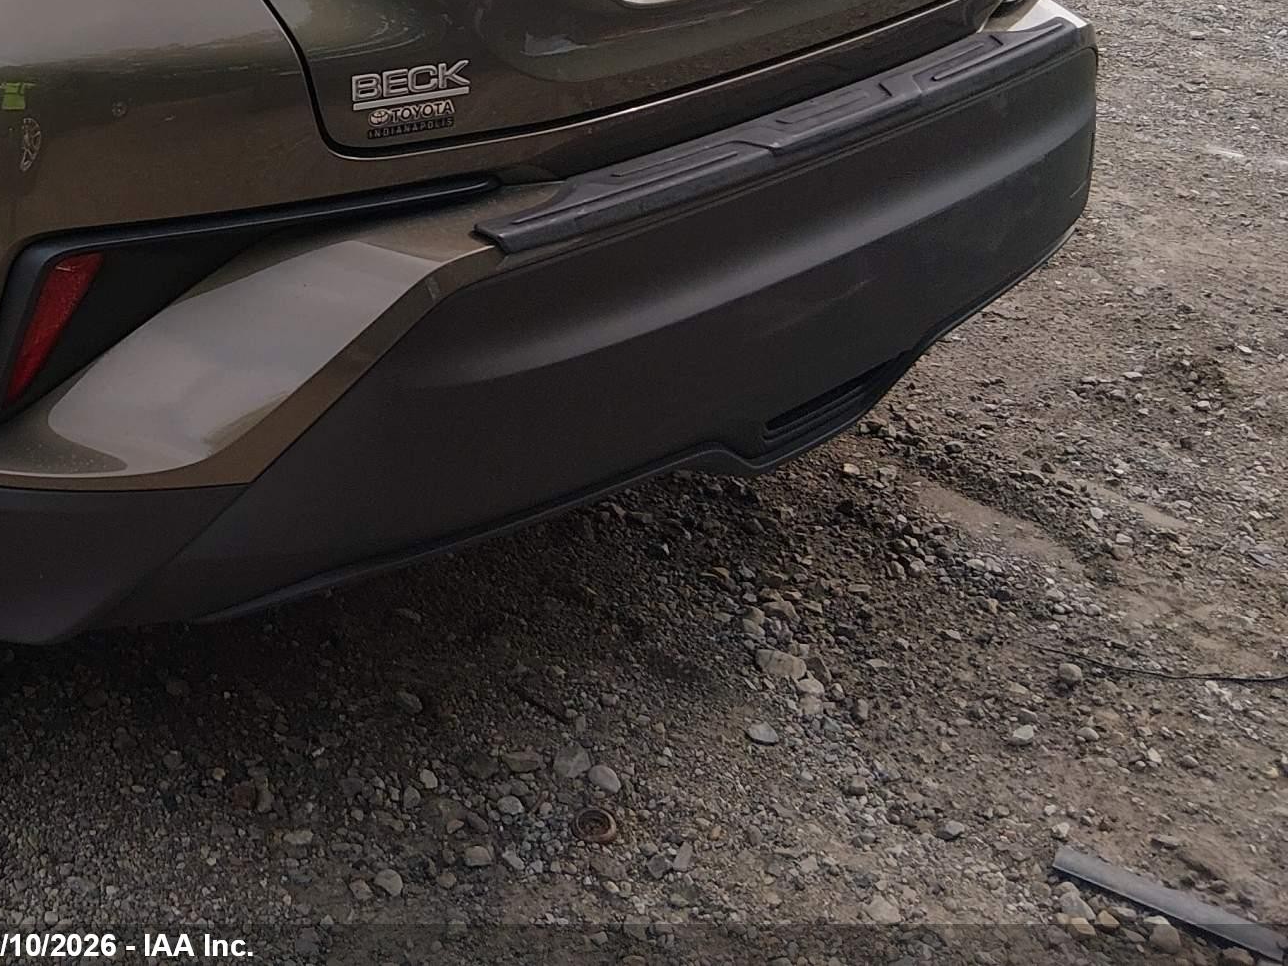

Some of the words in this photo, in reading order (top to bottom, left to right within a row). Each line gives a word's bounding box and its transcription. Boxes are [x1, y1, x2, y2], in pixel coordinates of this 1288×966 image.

[352, 59, 471, 103] BECK
[391, 98, 456, 123] TOYOTA
[368, 117, 454, 139] INDIANAPOLIS
